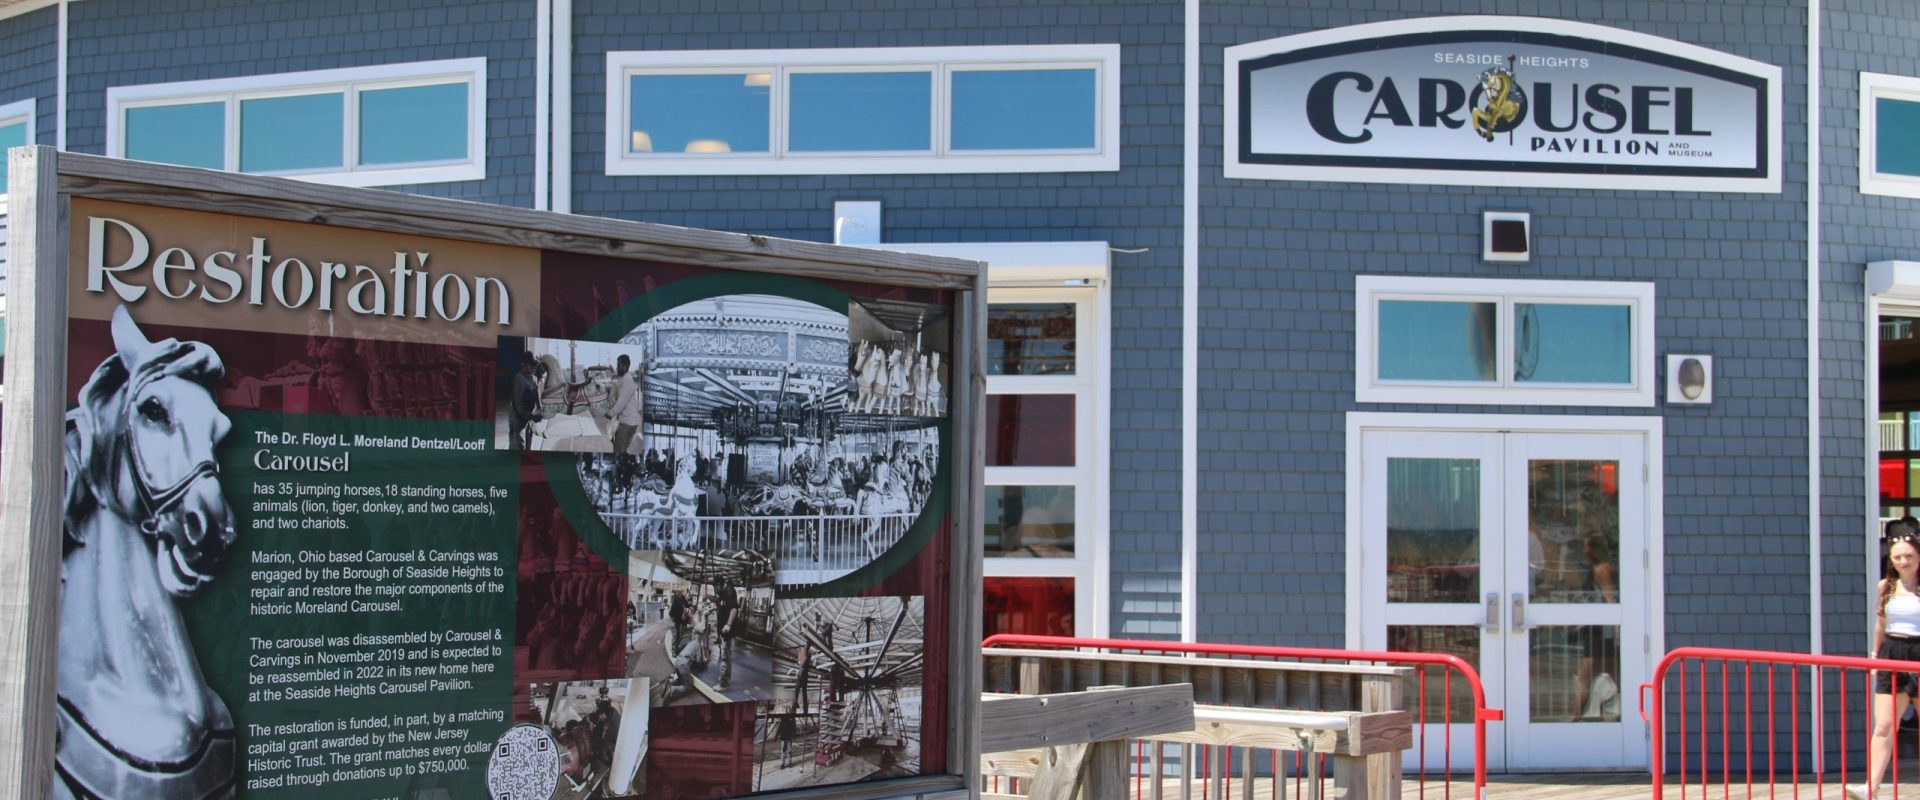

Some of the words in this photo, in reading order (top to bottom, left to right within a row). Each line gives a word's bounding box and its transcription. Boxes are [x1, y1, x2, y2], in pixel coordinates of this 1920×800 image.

[1434, 53, 1503, 65] SEASIDE
[1520, 56, 1589, 69] HEIGHTS
[1306, 71, 1712, 144] CAROUSEL
[1531, 137, 1659, 155] PAVILION
[86, 216, 510, 326] Restoration
[255, 430, 278, 444] The
[282, 432, 298, 444] Dr.
[302, 432, 336, 448] Floyd
[340, 434, 350, 446] L.
[354, 434, 408, 448] Moreland
[411, 436, 486, 450] Dentzel/Looff
[254, 449, 348, 471] Carousel
[253, 482, 275, 494] has
[278, 482, 293, 494] 35
[295, 482, 340, 498] jumping
[344, 483, 398, 497] horses,18
[401, 485, 446, 500] standing
[449, 485, 486, 499] horses,
[489, 486, 507, 498] five
[253, 499, 298, 512] animals
[301, 499, 328, 514] (lion,
[332, 500, 359, 515] tiger,
[362, 500, 404, 515] donkey,
[407, 501, 427, 512] and
[430, 502, 449, 513] two
[452, 502, 495, 516] camels),
[252, 516, 274, 529] and
[277, 517, 298, 528] two
[301, 516, 349, 529] chariots.
[251, 550, 294, 564] Marion,
[298, 550, 325, 562] Ohio
[328, 550, 362, 562] based
[366, 549, 414, 562] Carousel
[417, 549, 425, 561] &
[429, 549, 475, 564] Carvings
[477, 552, 498, 561] was
[251, 567, 301, 583] engaged
[305, 567, 319, 582] by
[322, 567, 339, 579] the
[343, 566, 389, 581] Borough
[392, 566, 404, 578] of
[406, 566, 449, 578] Seaside
[452, 565, 491, 580] Heights
[493, 566, 503, 576] to
[251, 585, 285, 600] repair
[287, 584, 309, 597] and
[312, 584, 351, 596] restore
[354, 583, 372, 595] the
[375, 582, 406, 597] major
[408, 582, 472, 596] components
[475, 581, 486, 593] of
[488, 581, 504, 592] the
[251, 601, 292, 615] historic
[295, 600, 347, 613] Moreland
[351, 599, 402, 612] Carousel.
[249, 637, 272, 649] The
[276, 634, 324, 649] carousel
[327, 636, 349, 646] was
[352, 631, 426, 645] disassembled
[430, 630, 442, 645] by
[445, 628, 491, 642] Carousel
[494, 628, 502, 640] &
[249, 653, 300, 668] Carvings
[304, 652, 314, 664] in
[317, 650, 375, 664] November
[377, 648, 405, 661] 2019
[407, 647, 427, 660] and
[430, 647, 439, 658] is
[442, 645, 489, 660] expected
[492, 645, 501, 656] to
[249, 672, 264, 684] be
[267, 668, 340, 683] reassembled
[343, 667, 353, 679] in
[356, 665, 383, 679] 2022
[387, 665, 396, 677] in
[399, 664, 411, 676] its
[414, 666, 436, 675] new
[439, 663, 468, 674] home
[471, 661, 494, 672] here
[248, 689, 260, 702] at
[263, 688, 281, 701] the
[285, 685, 331, 700] Seaside
[334, 683, 376, 698] Heights
[379, 679, 427, 694] Carousel
[430, 678, 473, 691] Pavilion.
[248, 724, 271, 736] The
[274, 720, 334, 734] restoration
[337, 718, 347, 730] is
[349, 715, 390, 729] funded,
[394, 714, 403, 726] in
[406, 713, 429, 728] part,
[433, 712, 446, 727] by
[448, 713, 455, 722] a
[458, 708, 503, 722] matching
[248, 739, 285, 756] capital
[289, 737, 318, 754] grant
[321, 733, 369, 748] awarded
[372, 733, 385, 747] by
[388, 731, 405, 743] the
[408, 729, 432, 742] New
[434, 729, 469, 743] Jersey
[248, 756, 291, 772] Historic
[294, 754, 325, 767] Trust.
[329, 752, 351, 764] The
[354, 749, 382, 765] grant
[385, 746, 430, 760] matches
[432, 745, 461, 757] every
[463, 741, 492, 753] dollar
[247, 774, 283, 789] raised
[286, 770, 329, 786] through
[332, 766, 386, 781] donations
[389, 766, 402, 779] up
[405, 763, 415, 775] to
[418, 758, 469, 775] $750,000.
